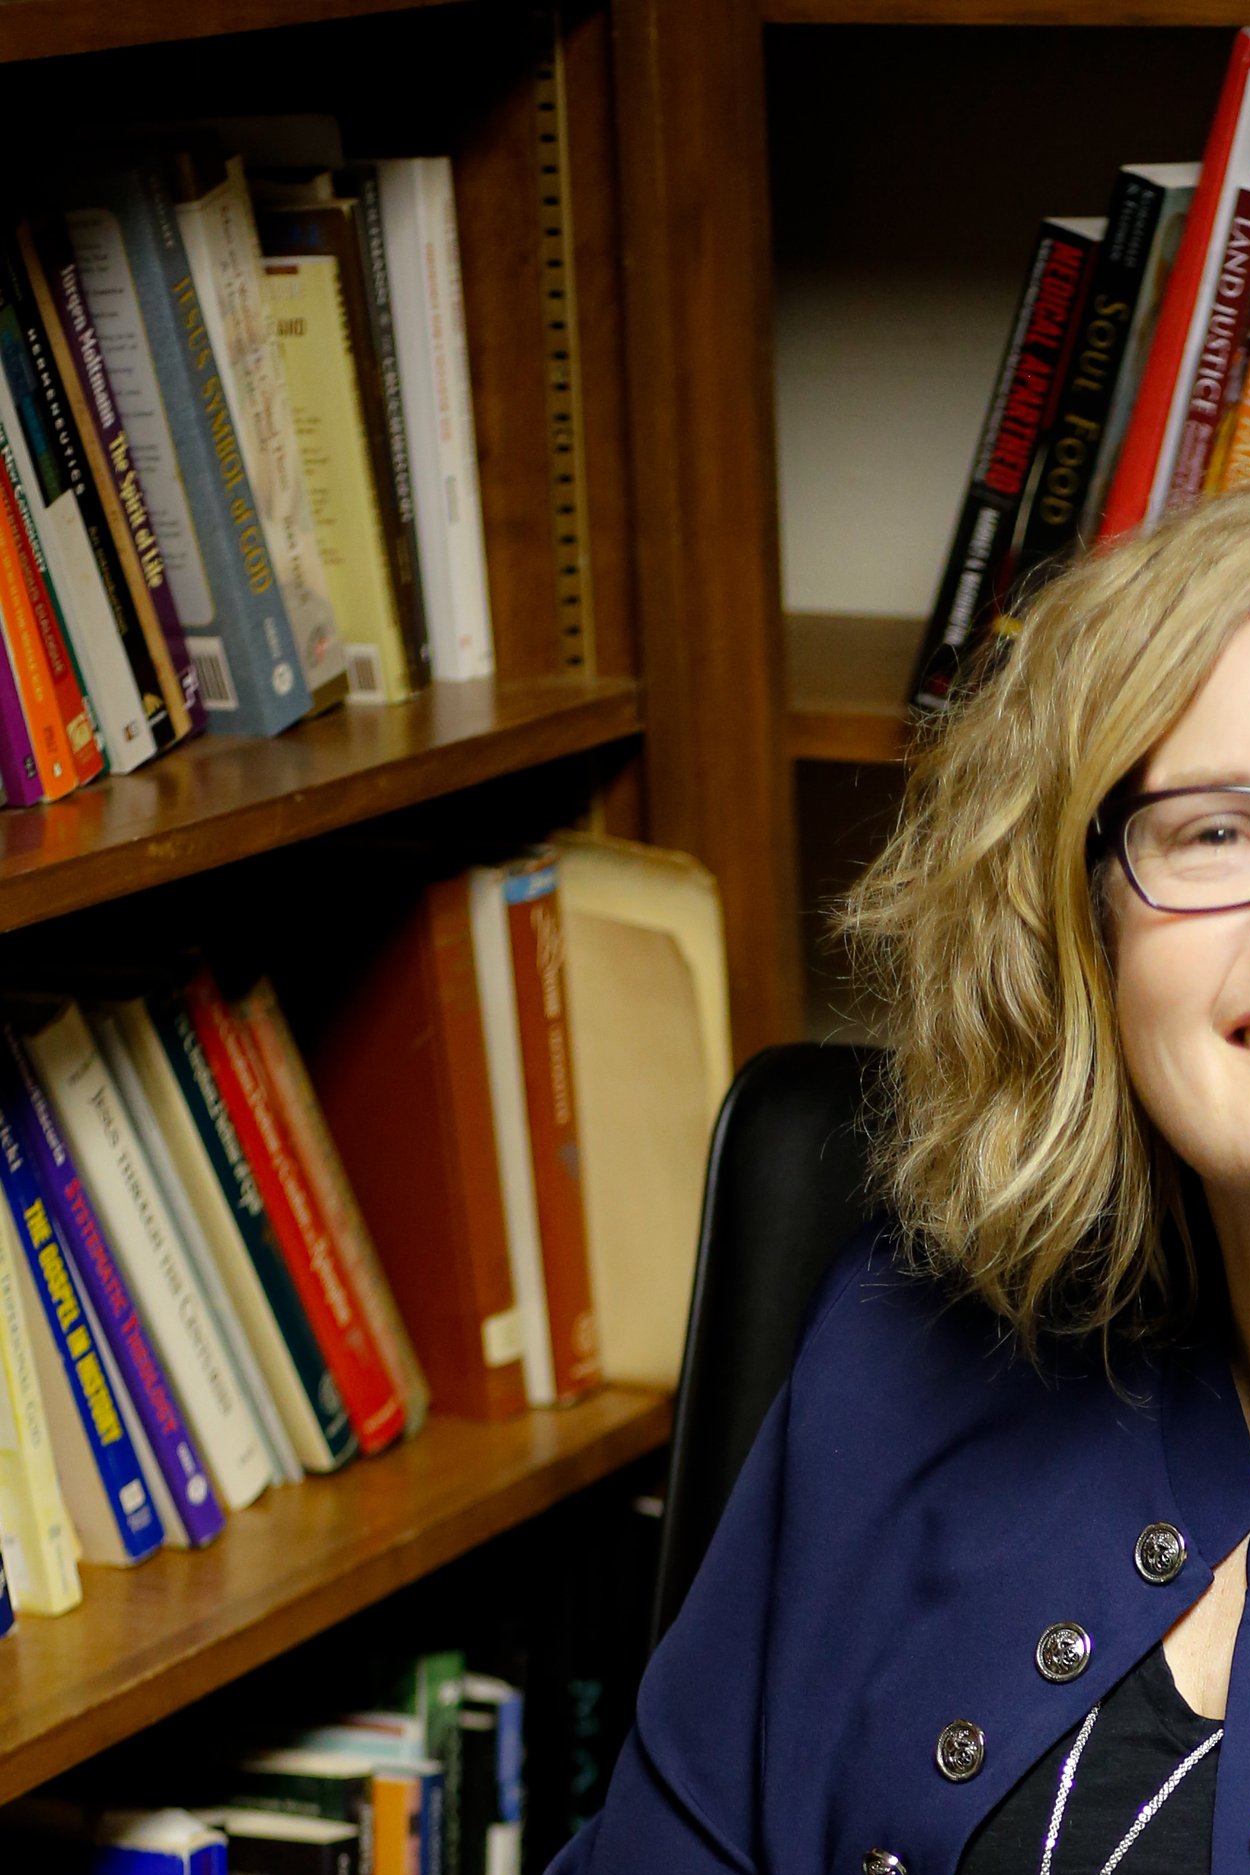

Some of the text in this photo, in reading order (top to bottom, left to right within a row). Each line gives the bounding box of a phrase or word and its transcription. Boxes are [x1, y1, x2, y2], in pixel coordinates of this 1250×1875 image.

[1023, 238, 1089, 353] MEDICAL
[1180, 300, 1245, 417] JUSTICE
[25, 326, 86, 496] HERMENEUTICS
[75, 326, 119, 429] Moltmann
[171, 275, 212, 372] JESUS
[197, 373, 247, 496] SYMBOL
[236, 523, 274, 596] GOD
[980, 351, 1057, 497] APARTHEID
[1036, 292, 1129, 530] SOUL FOOD
[106, 430, 166, 590] The Spirit of Life
[21, 1197, 125, 1447] THE GOSPEL IN HISTORY
